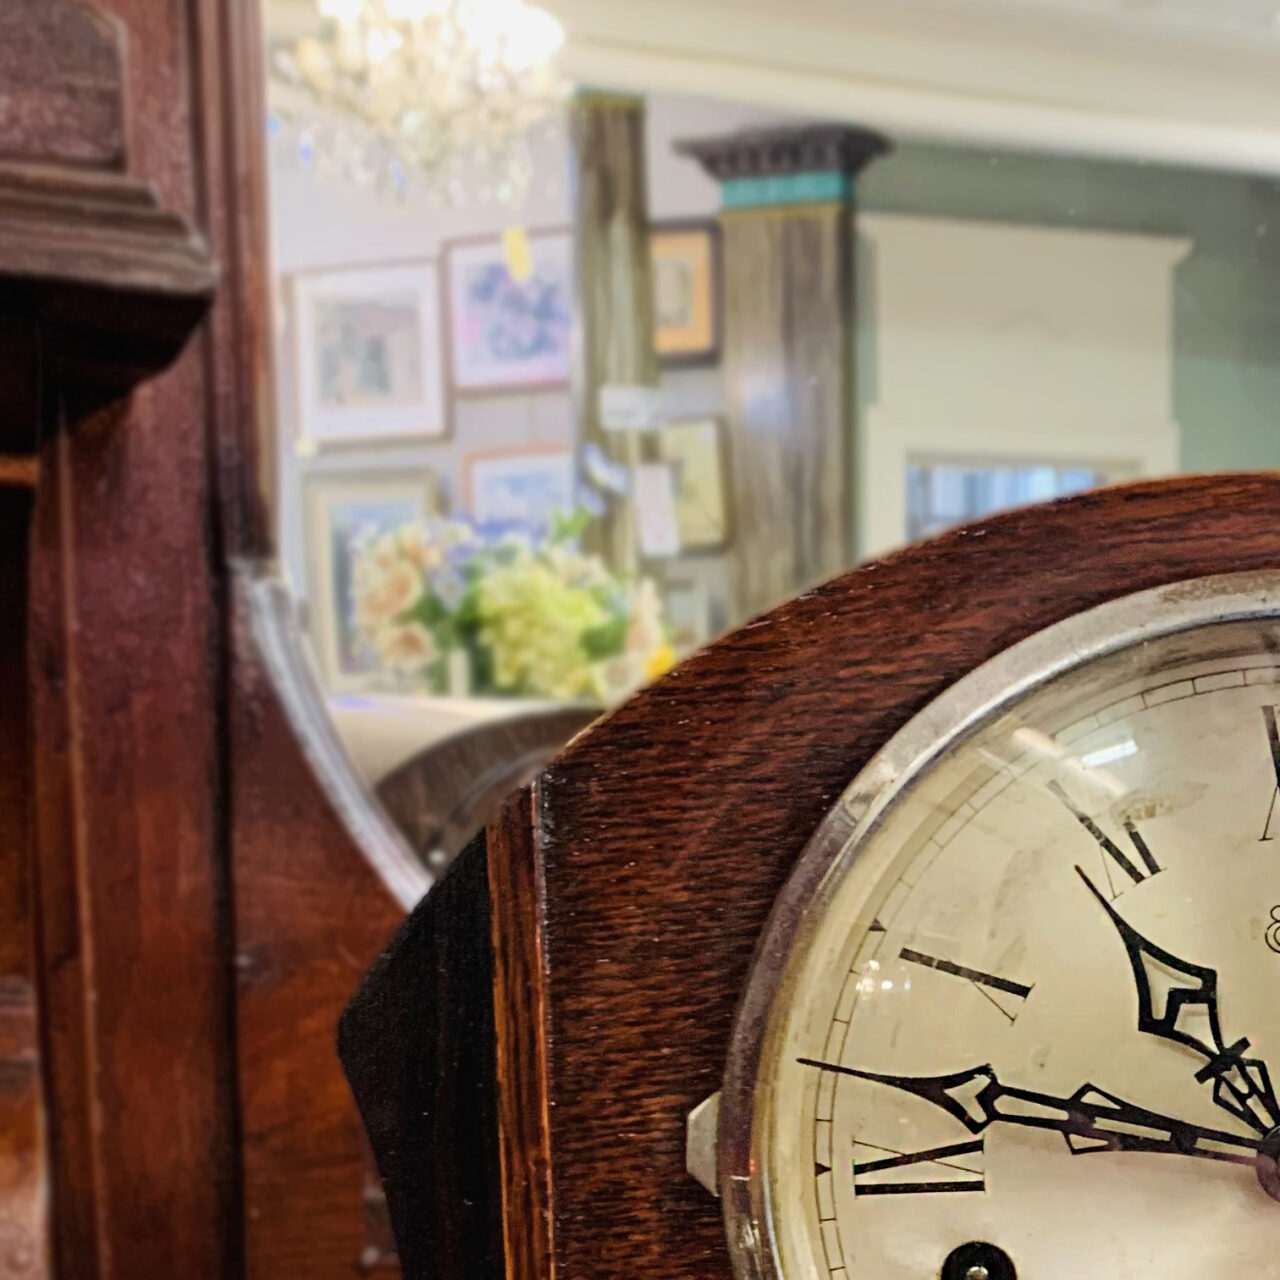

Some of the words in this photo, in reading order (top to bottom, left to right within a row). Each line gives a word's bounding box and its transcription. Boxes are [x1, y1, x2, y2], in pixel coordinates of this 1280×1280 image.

[1048, 778, 1168, 902] XI
[899, 947, 1036, 1026] X
[852, 1138, 986, 1200] IX
